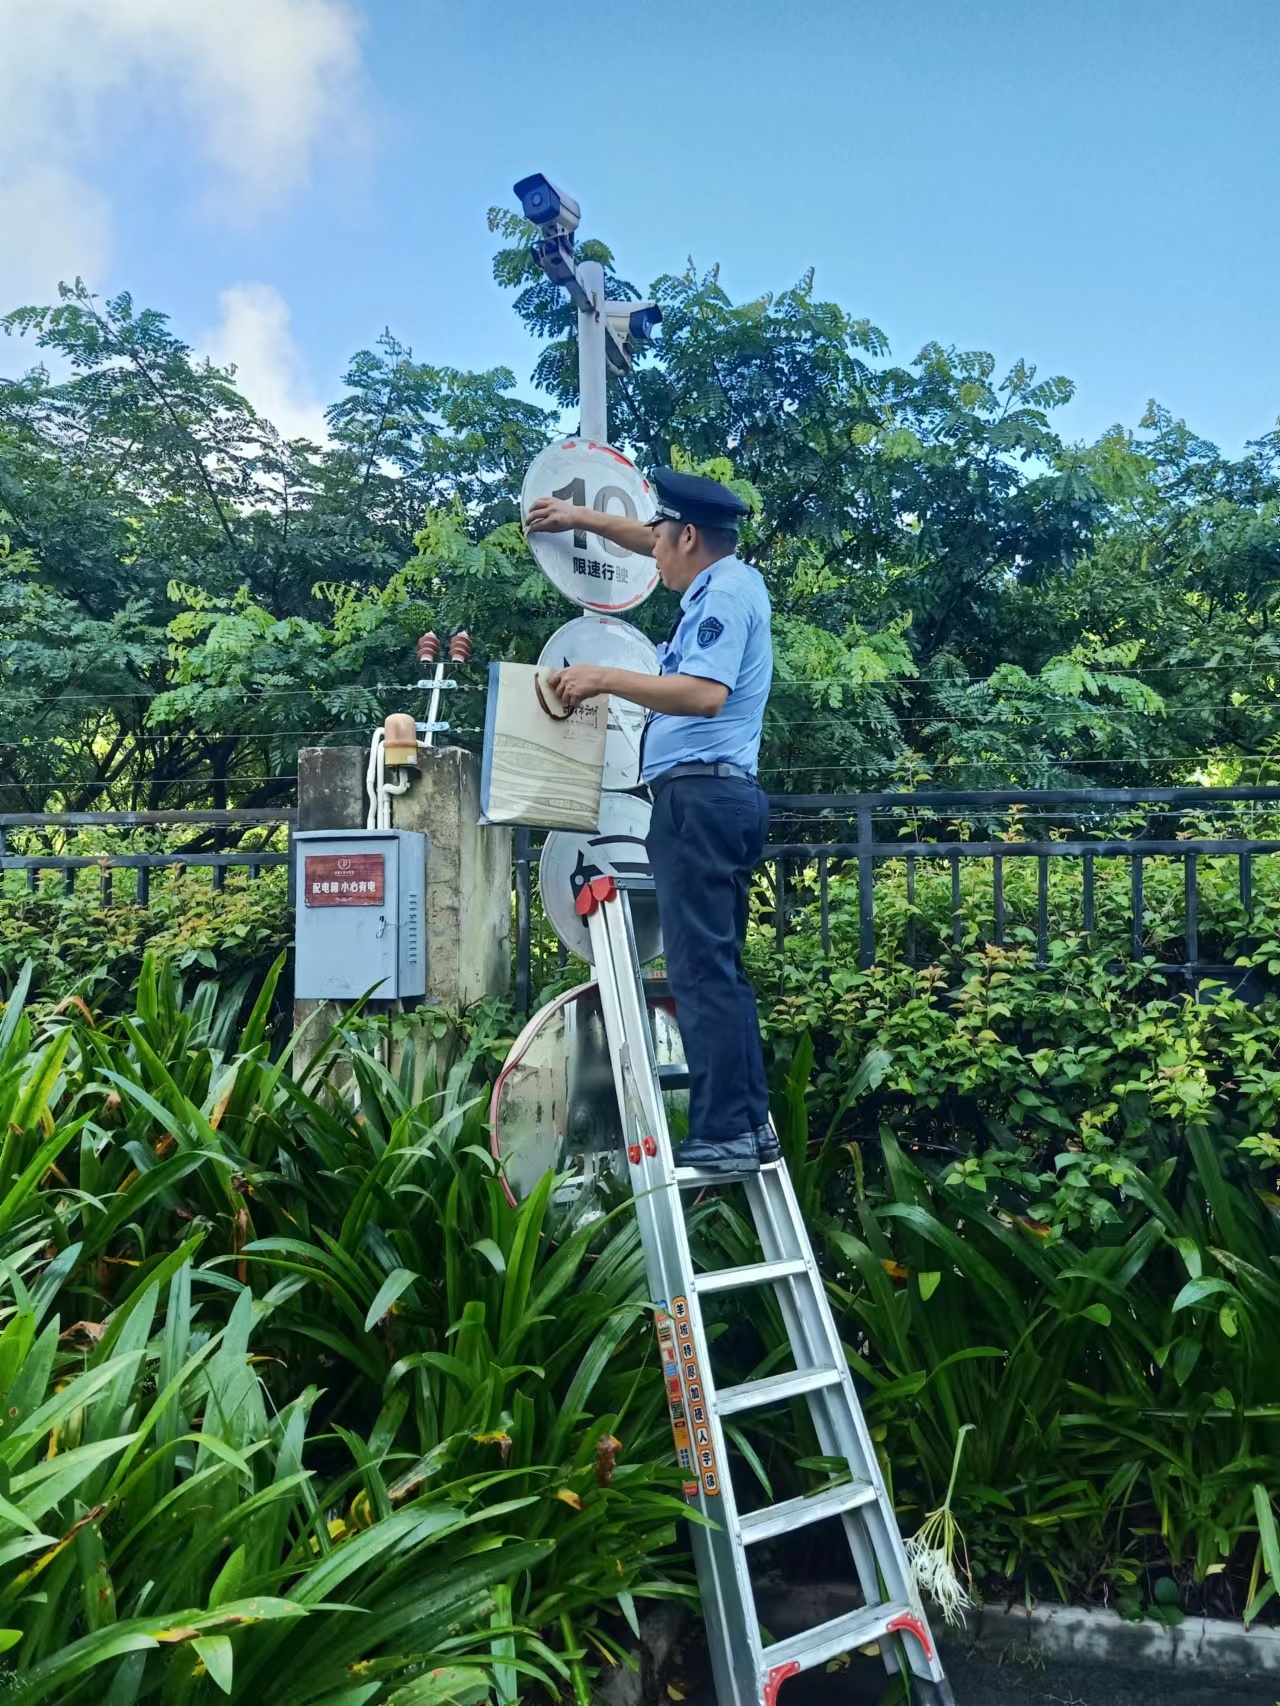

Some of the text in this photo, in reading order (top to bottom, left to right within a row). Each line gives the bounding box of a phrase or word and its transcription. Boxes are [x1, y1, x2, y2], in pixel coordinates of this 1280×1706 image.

[552, 477, 638, 558] 10
[573, 557, 629, 583] 限速行驶
[312, 881, 376, 894] 配电箱 小心有电
